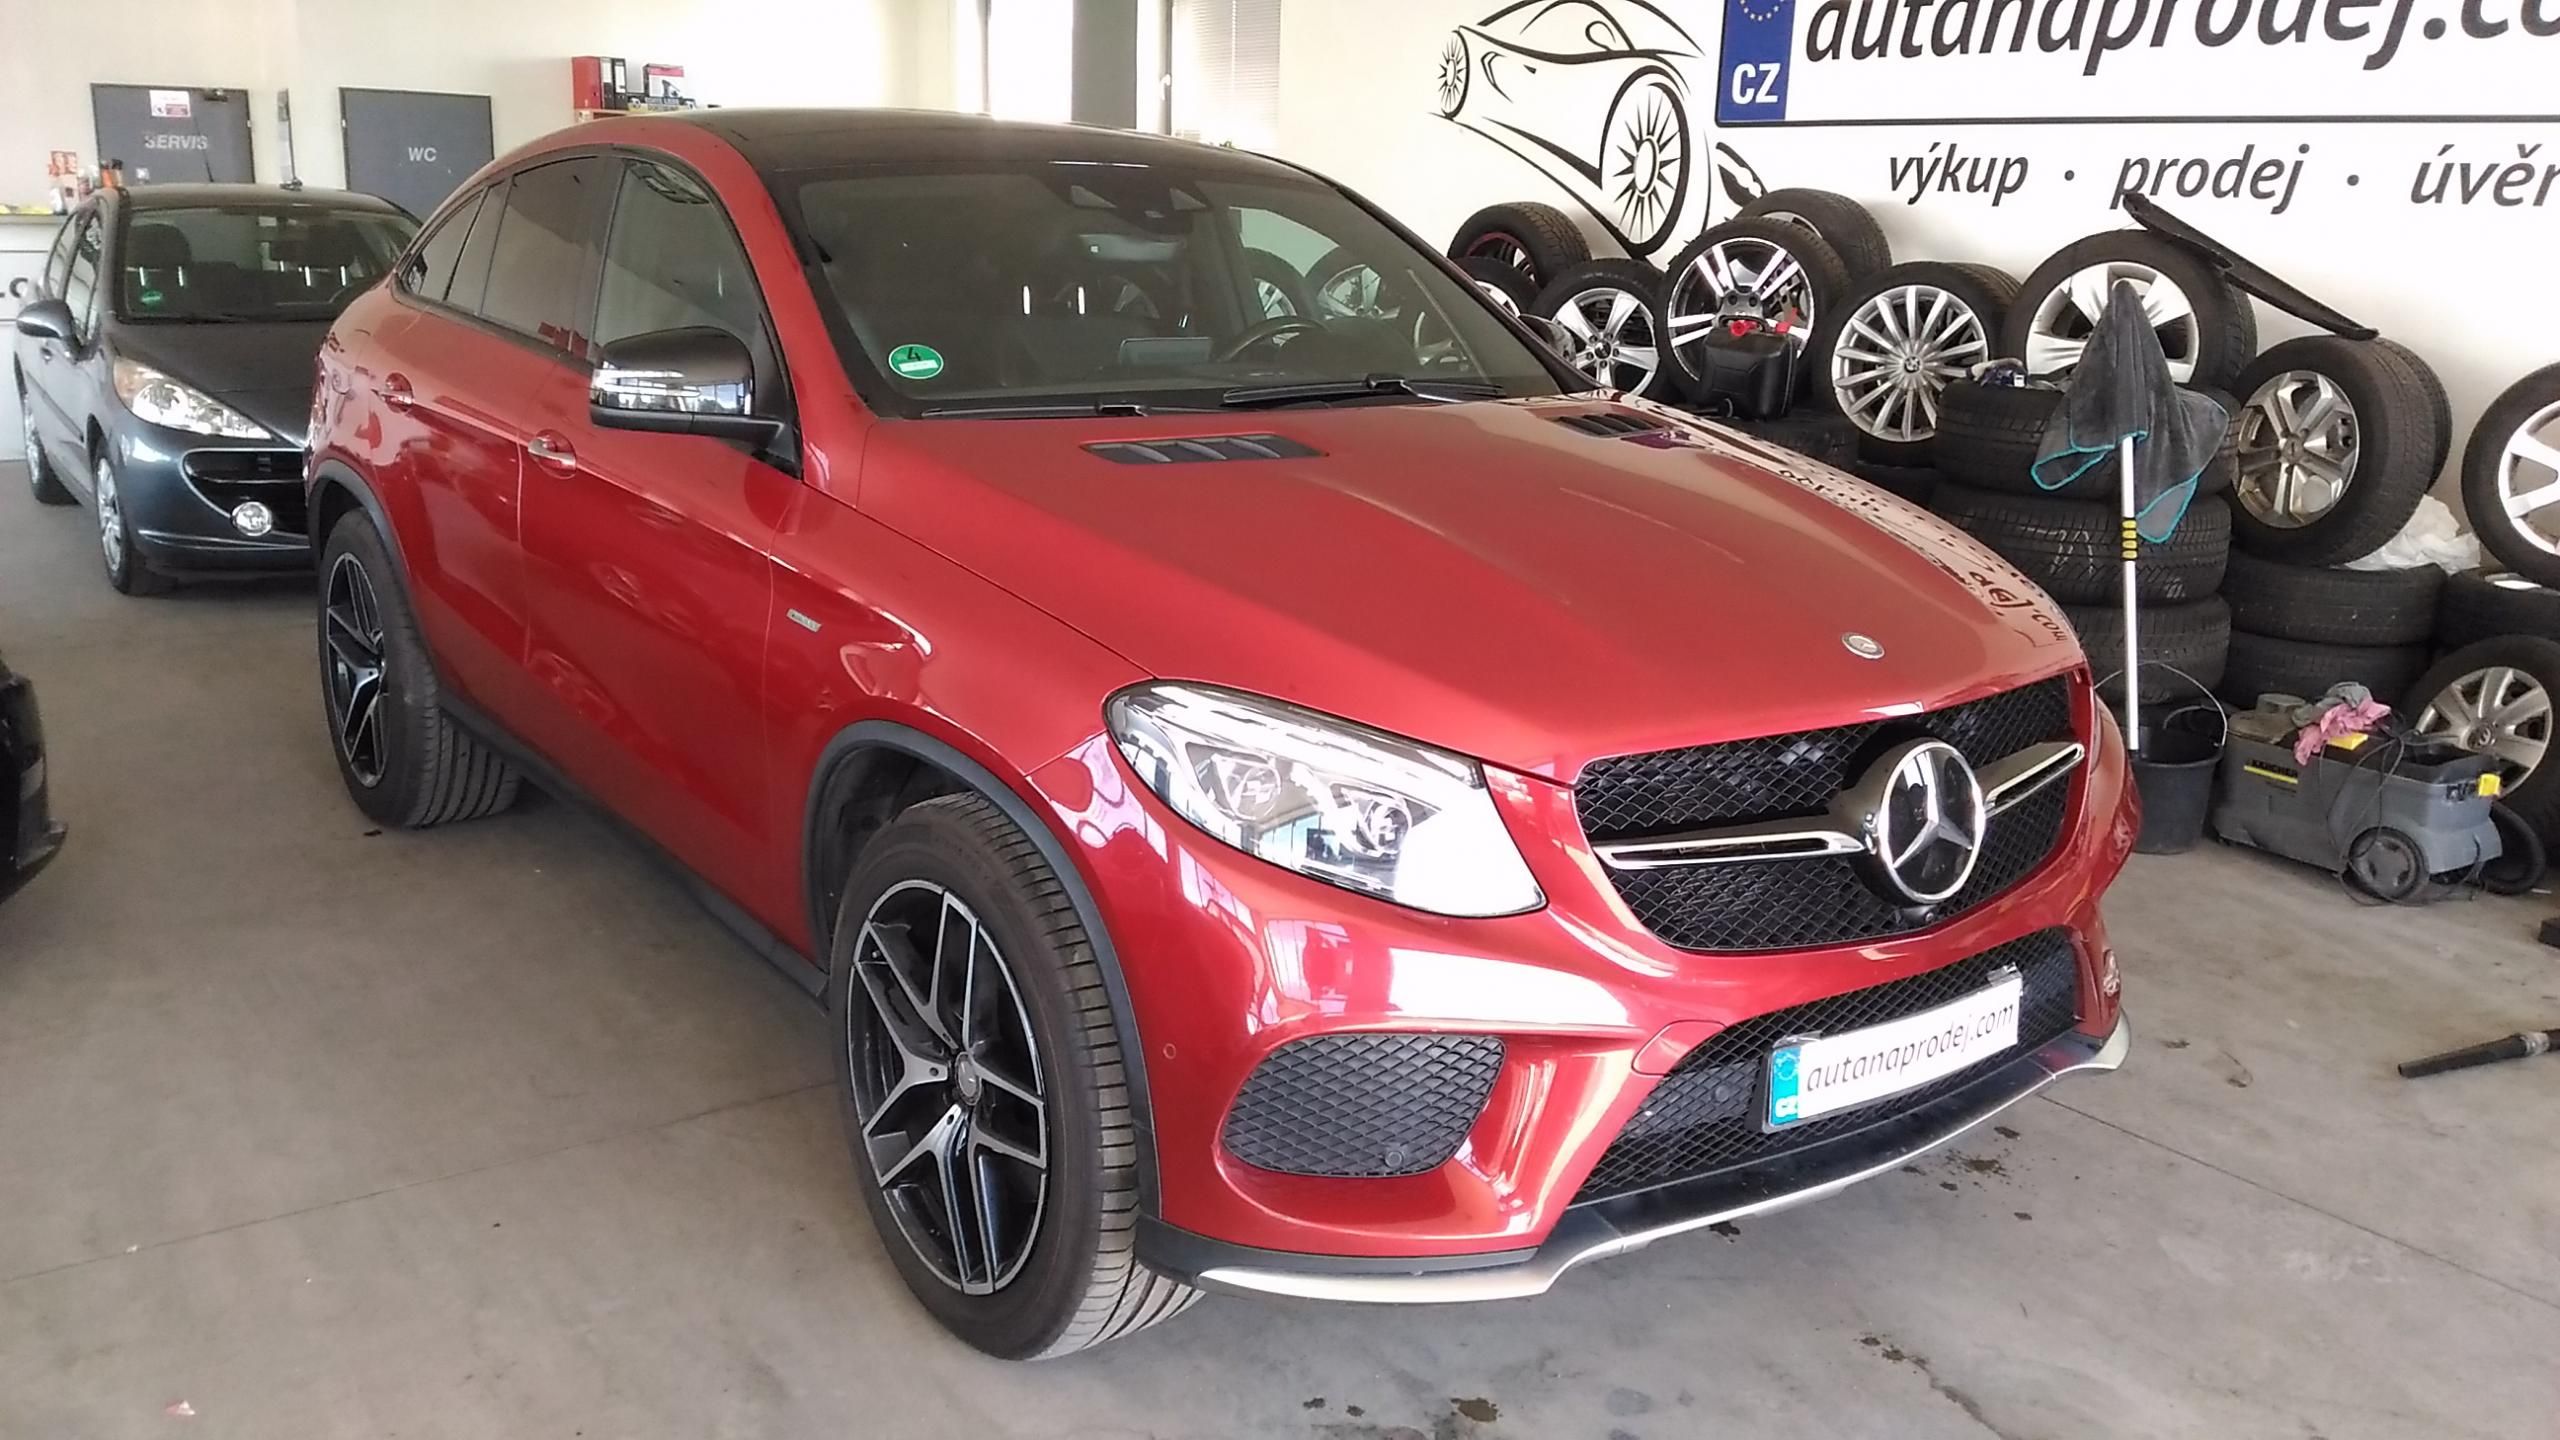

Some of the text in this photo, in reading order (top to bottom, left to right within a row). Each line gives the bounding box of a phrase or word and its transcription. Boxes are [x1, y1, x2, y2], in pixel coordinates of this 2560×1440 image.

[1731, 62, 1781, 105] CZ
[144, 134, 208, 150] SERVIS
[408, 146, 437, 162] WC
[1889, 142, 2560, 215] výkup prodej úvěr
[907, 347, 921, 361] 4
[1805, 1001, 2015, 1093] autanaprodej.com
